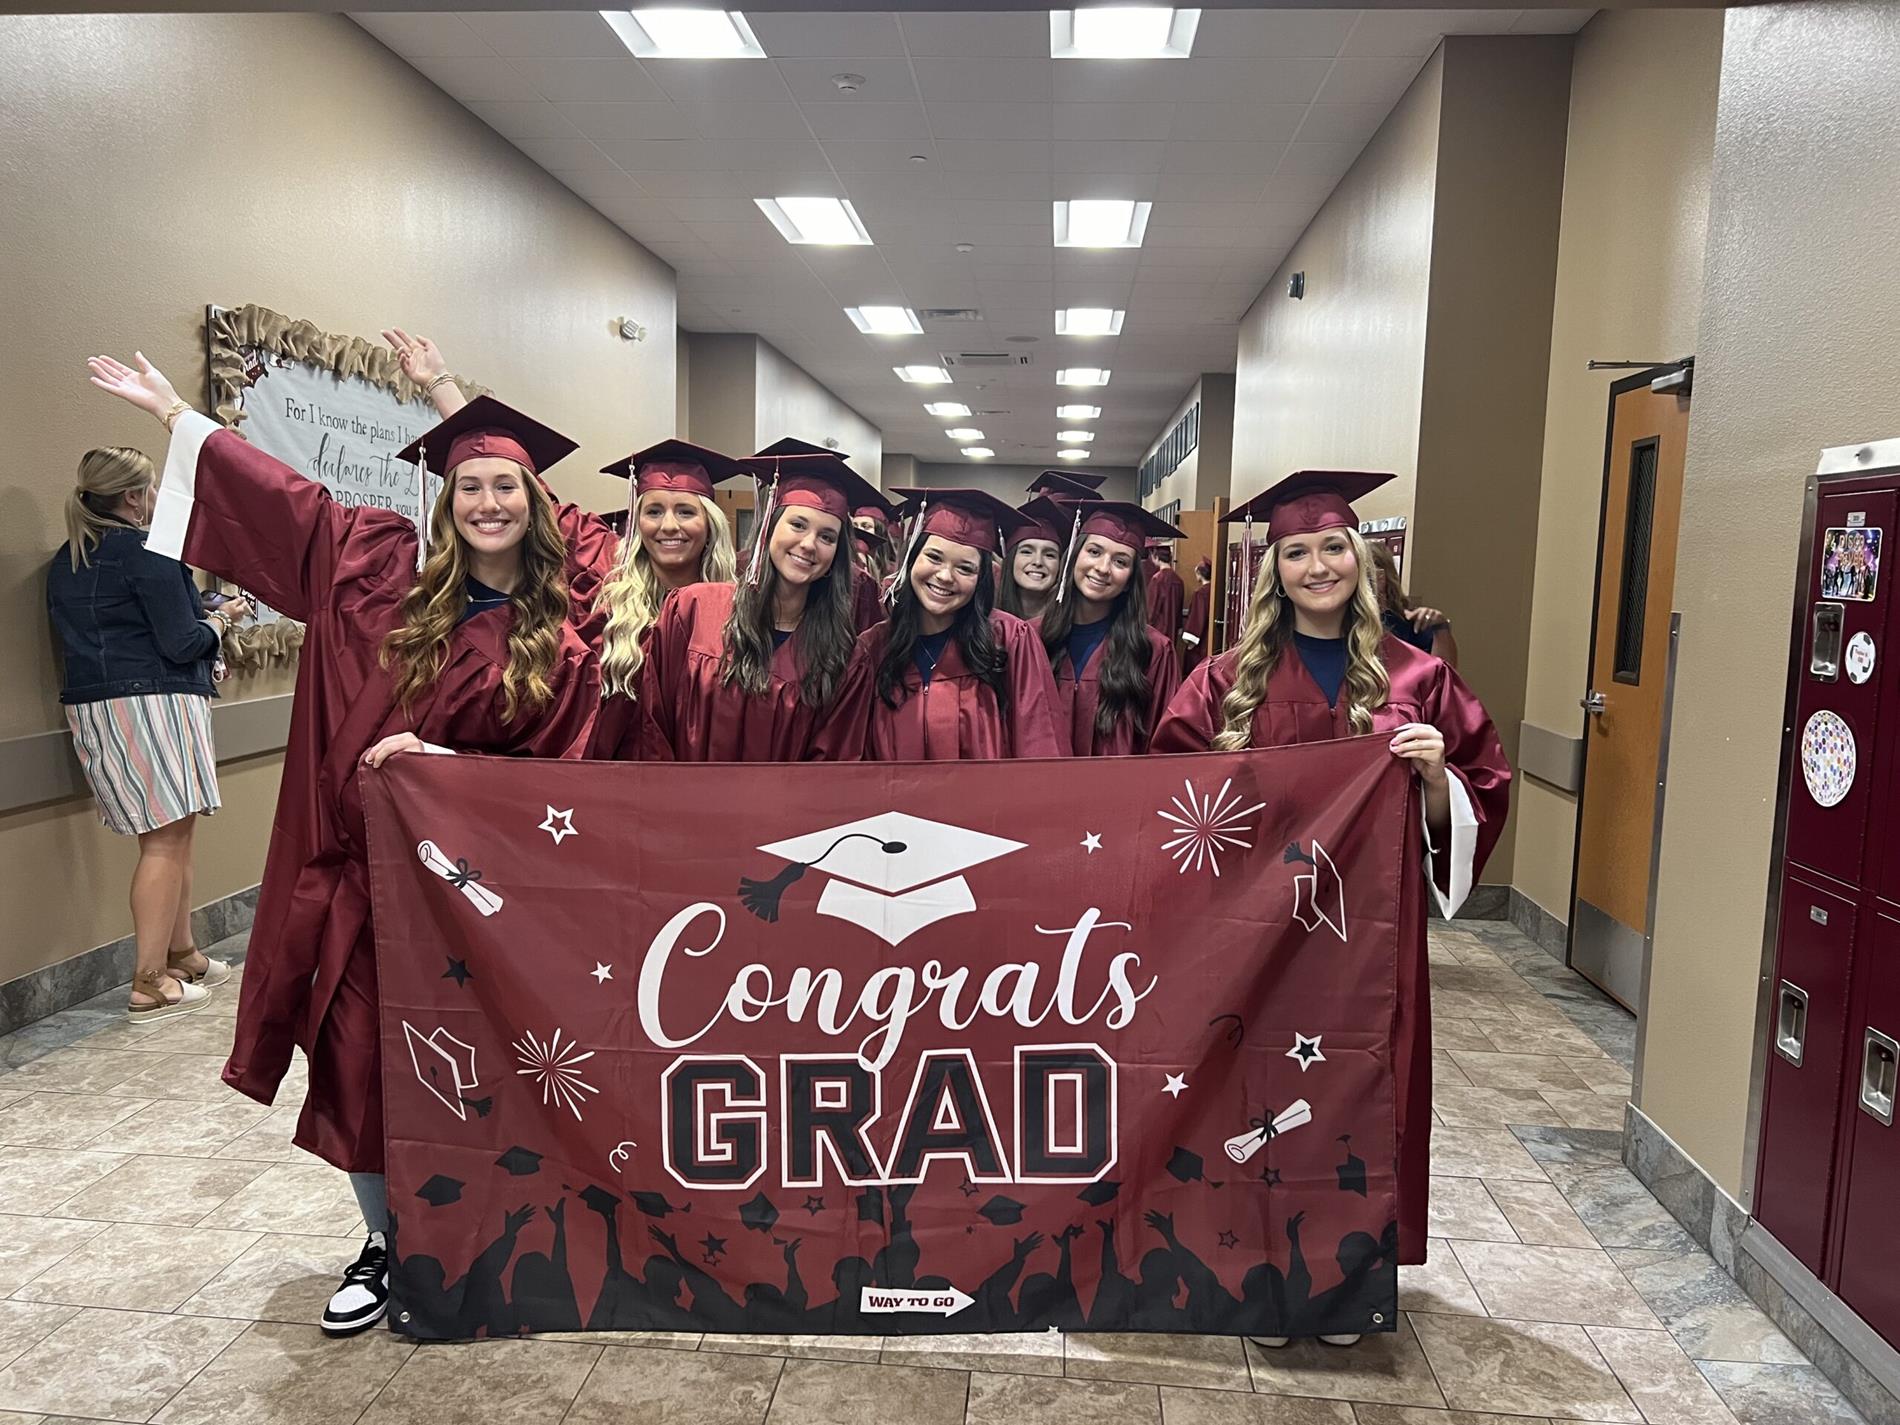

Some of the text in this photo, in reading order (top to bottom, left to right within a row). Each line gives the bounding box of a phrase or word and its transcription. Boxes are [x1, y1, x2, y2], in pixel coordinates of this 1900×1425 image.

[285, 397, 421, 446] For I know the plans I ha
[307, 432, 372, 487] declares
[335, 490, 392, 512] PROSPER
[395, 503, 412, 516] you
[637, 902, 1159, 1072] Congrats
[660, 1042, 1118, 1190] GRAD
[868, 1295, 955, 1308] WAY TO GO
